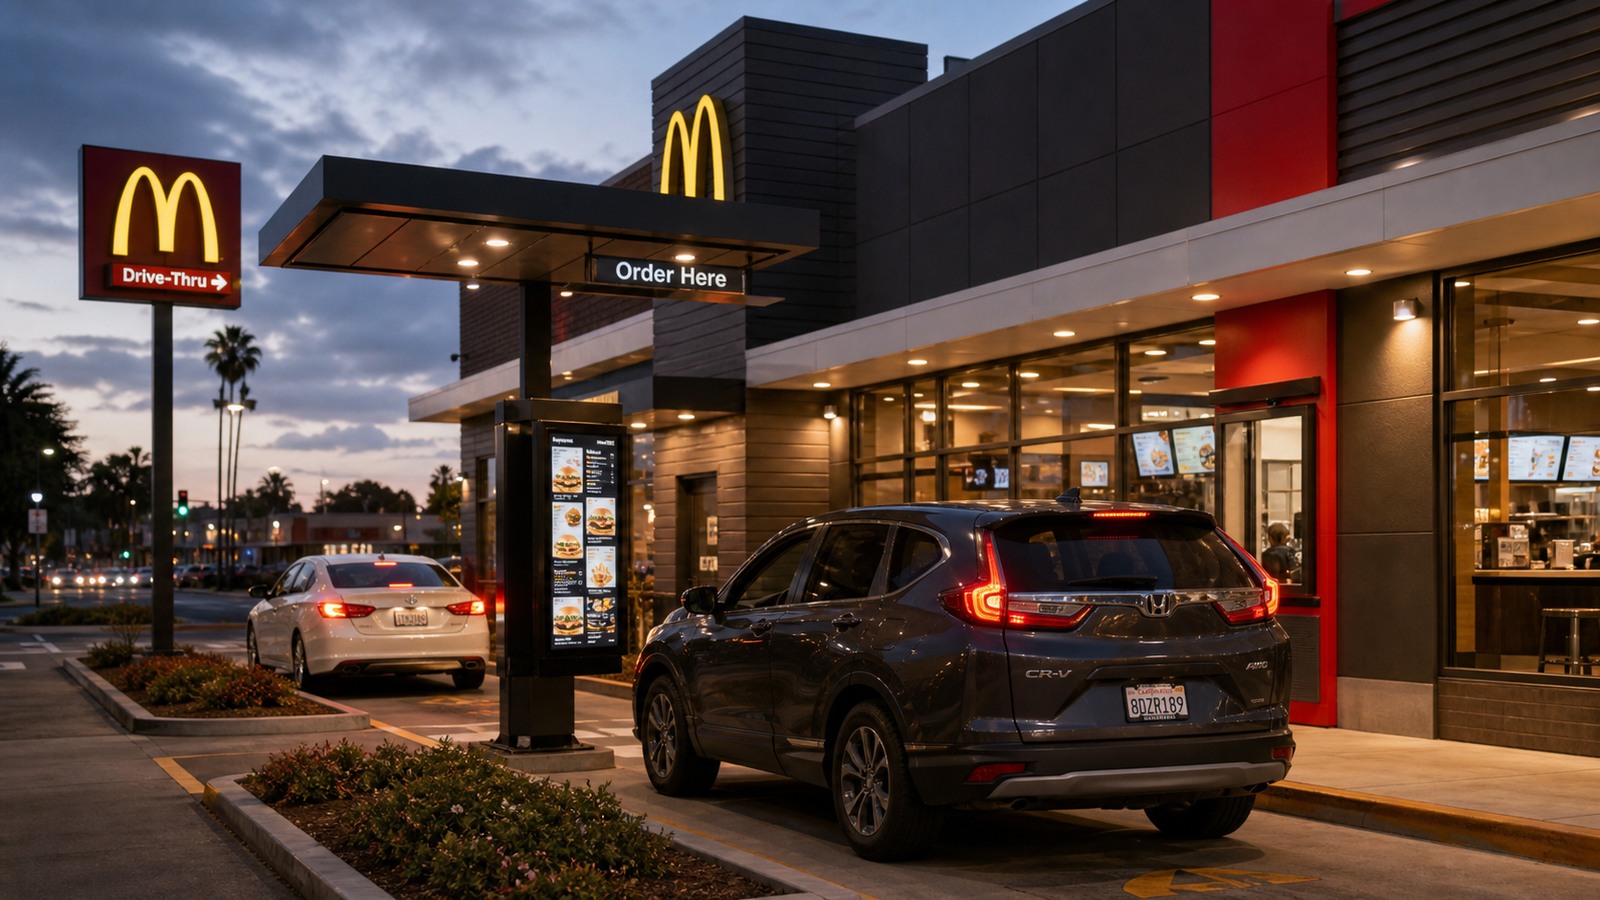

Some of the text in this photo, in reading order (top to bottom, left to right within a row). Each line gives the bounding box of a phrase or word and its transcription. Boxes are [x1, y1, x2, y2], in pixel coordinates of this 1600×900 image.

[122, 267, 207, 288] Drive-Thru
[615, 261, 727, 287] Order Here
[1025, 669, 1072, 679] CR-V
[1130, 696, 1184, 715] 8DZR189
